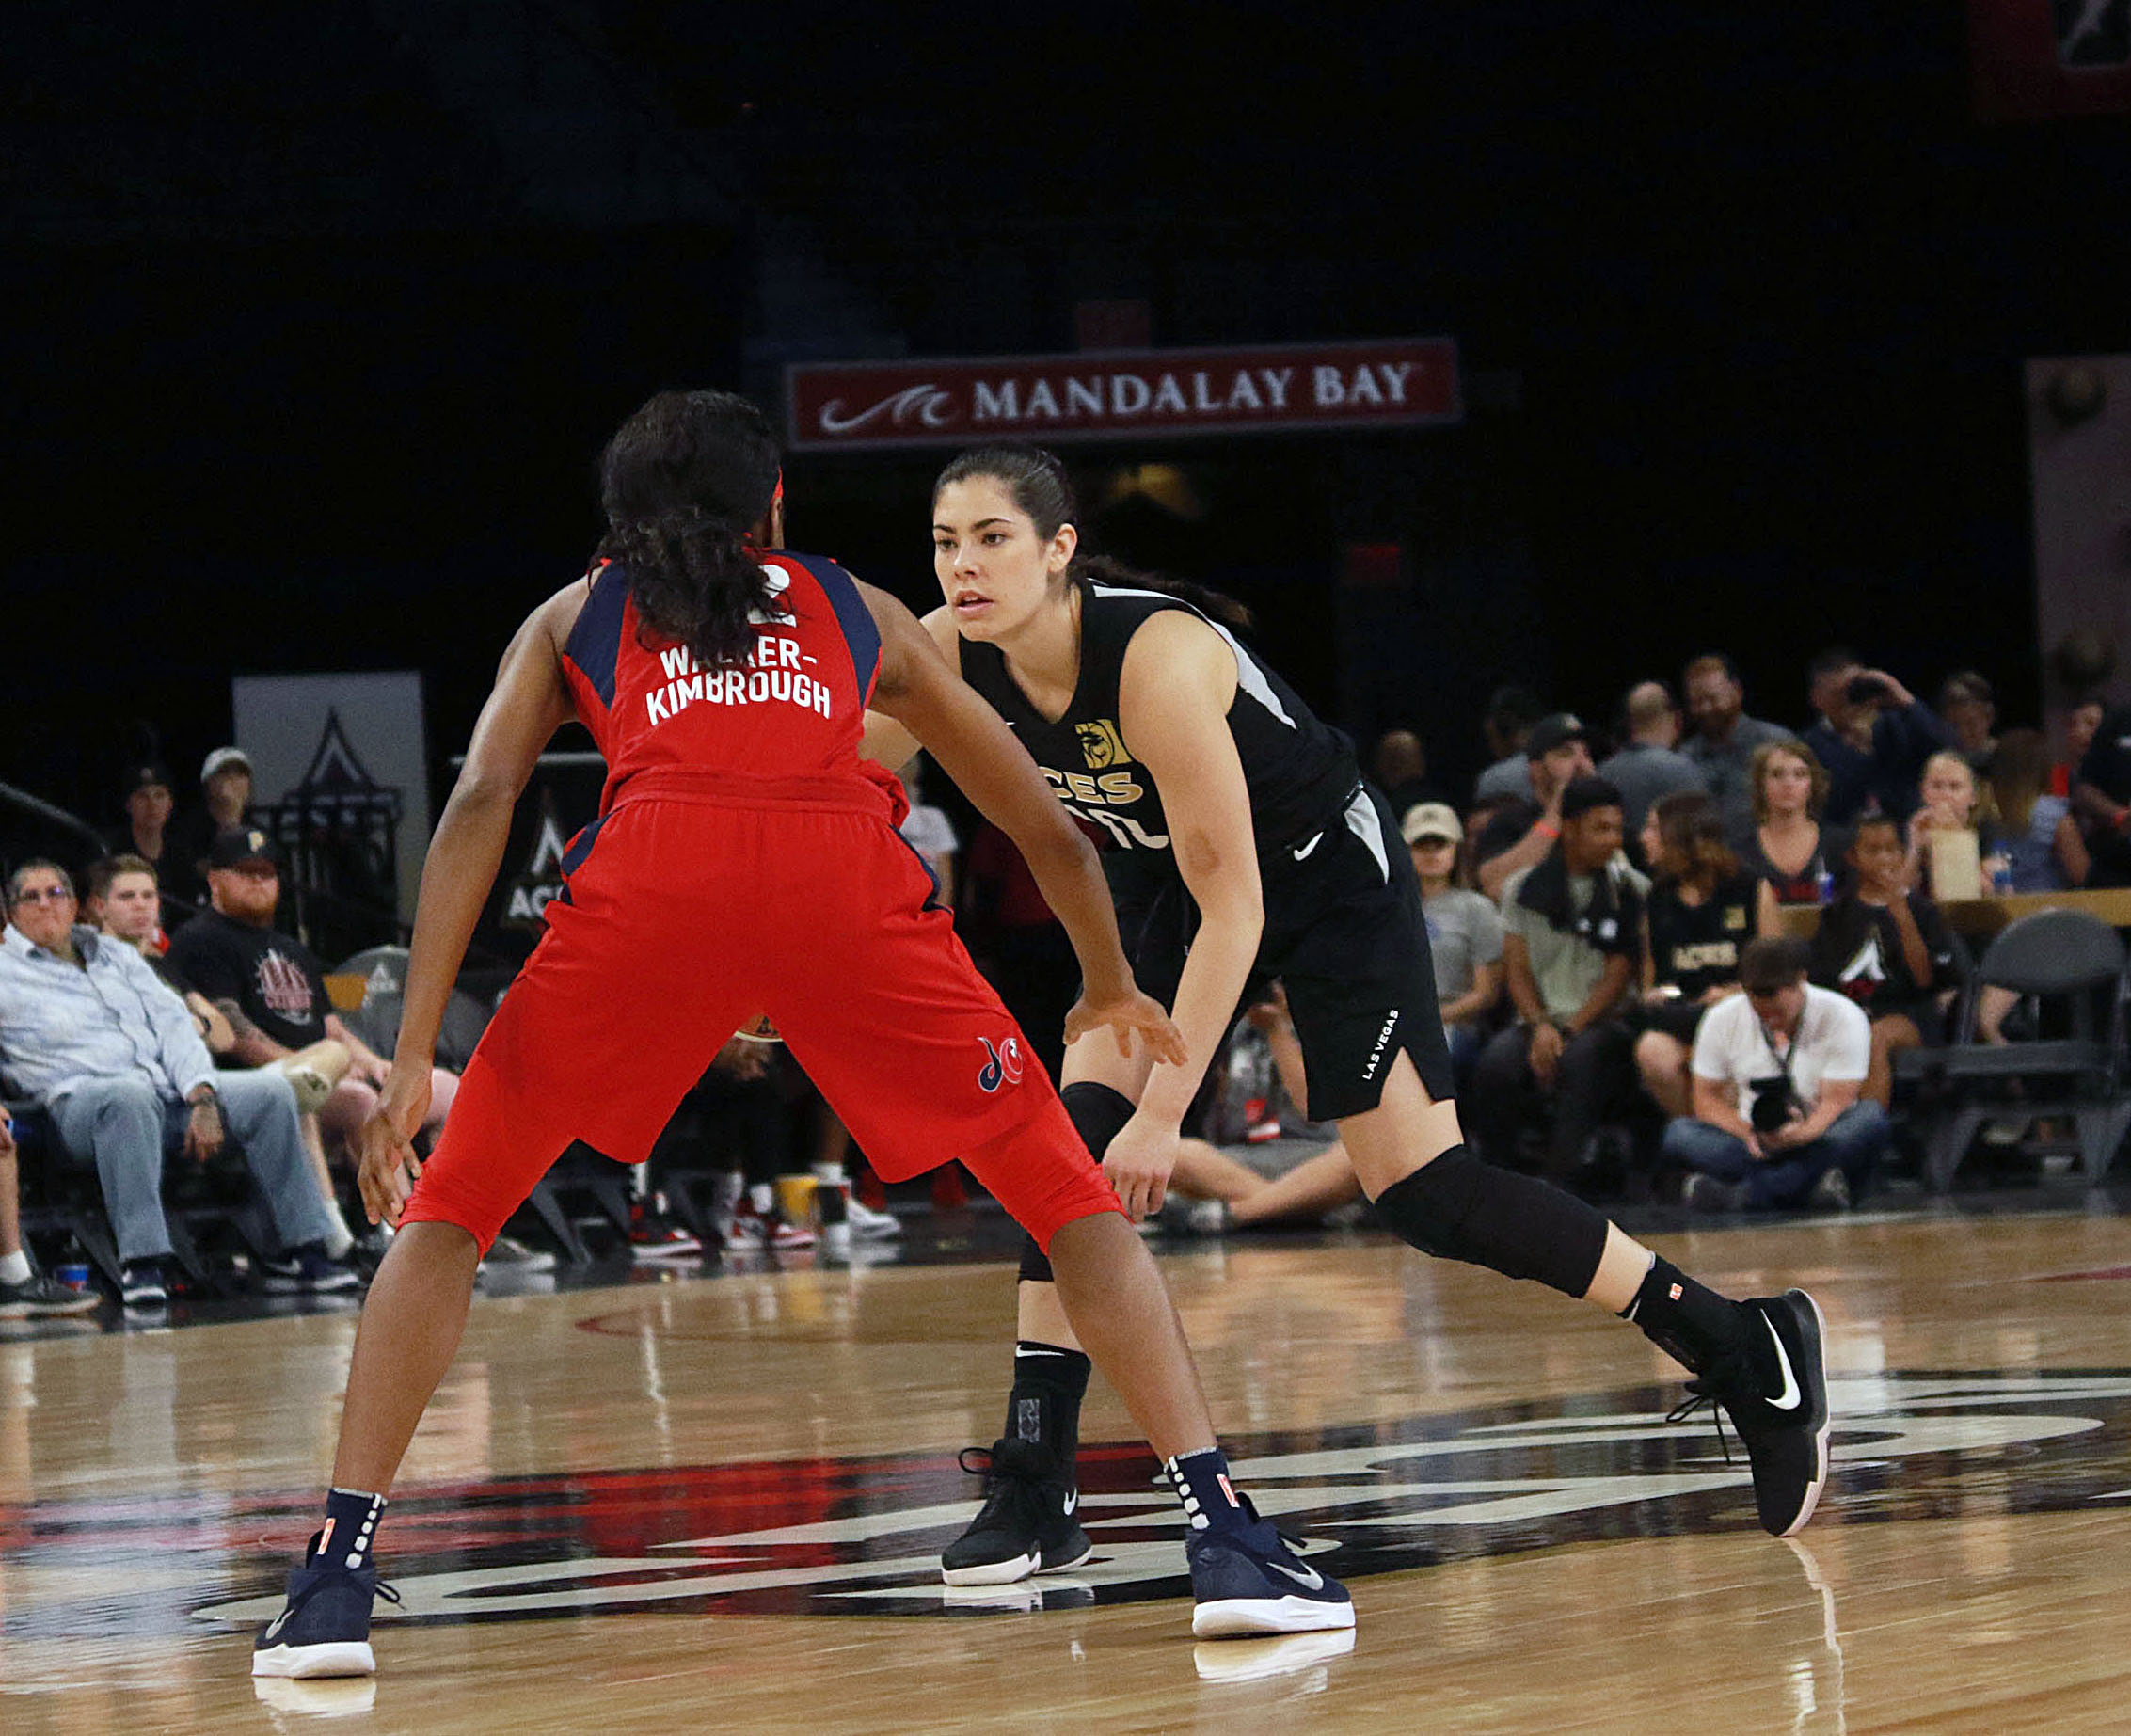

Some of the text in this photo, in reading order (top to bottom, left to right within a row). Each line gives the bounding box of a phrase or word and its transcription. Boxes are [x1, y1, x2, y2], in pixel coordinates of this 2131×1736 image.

[974, 360, 1413, 420] MANDALAY BAY
[660, 635, 817, 680] WER-
[645, 669, 831, 726] KIMBROUGH
[1037, 766, 1144, 805] CES
[1361, 1009, 1399, 1080] LAS VEGAS
